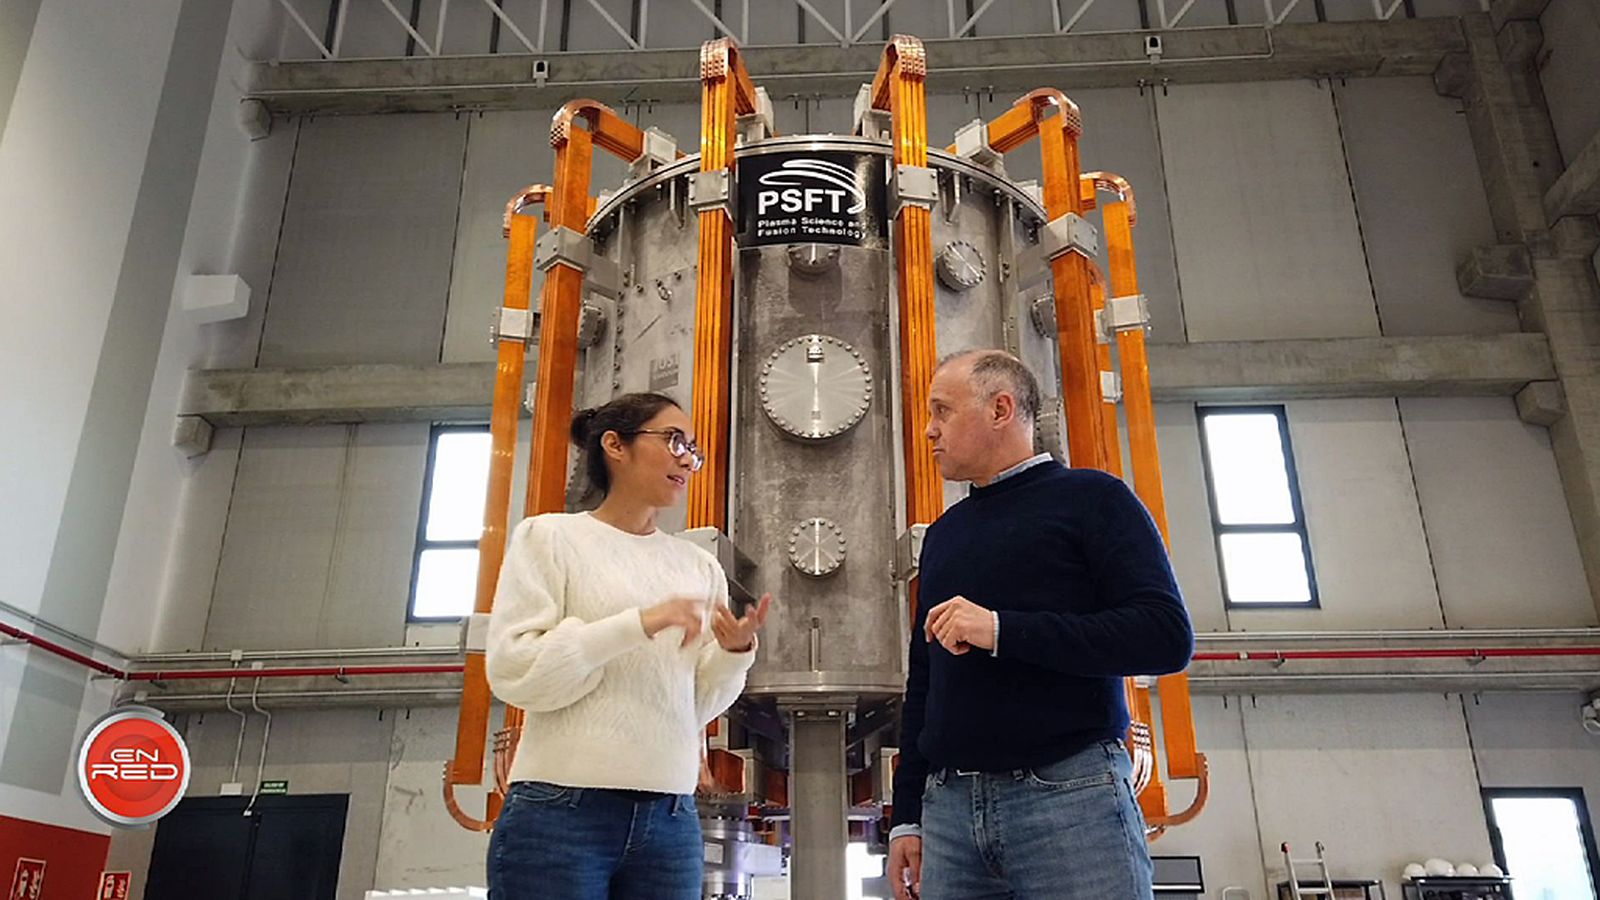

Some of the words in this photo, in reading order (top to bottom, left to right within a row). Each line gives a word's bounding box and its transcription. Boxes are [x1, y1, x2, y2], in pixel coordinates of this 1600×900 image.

[758, 188, 846, 215] PSFT
[757, 217, 797, 228] Plasma
[801, 217, 844, 227] Science
[757, 227, 797, 237] Fusion
[801, 226, 867, 239] Technology
